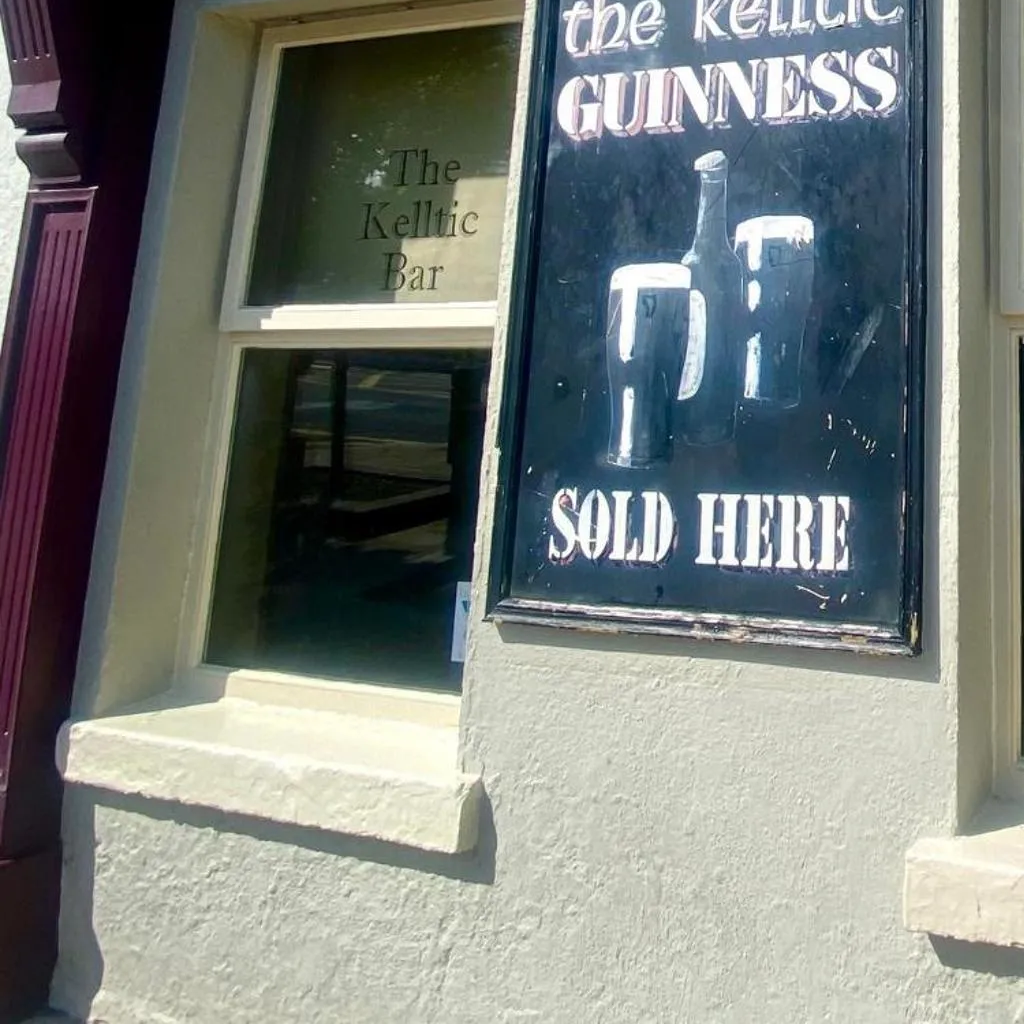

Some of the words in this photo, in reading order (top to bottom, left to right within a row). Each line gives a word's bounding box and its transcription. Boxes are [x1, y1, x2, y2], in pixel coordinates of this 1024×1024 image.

[556, 45, 902, 141] GUINNESS
[389, 147, 462, 188] The
[356, 199, 480, 241] Kelltic
[379, 251, 445, 293] Bar
[547, 485, 678, 564] SOLD
[694, 492, 853, 576] HERE
